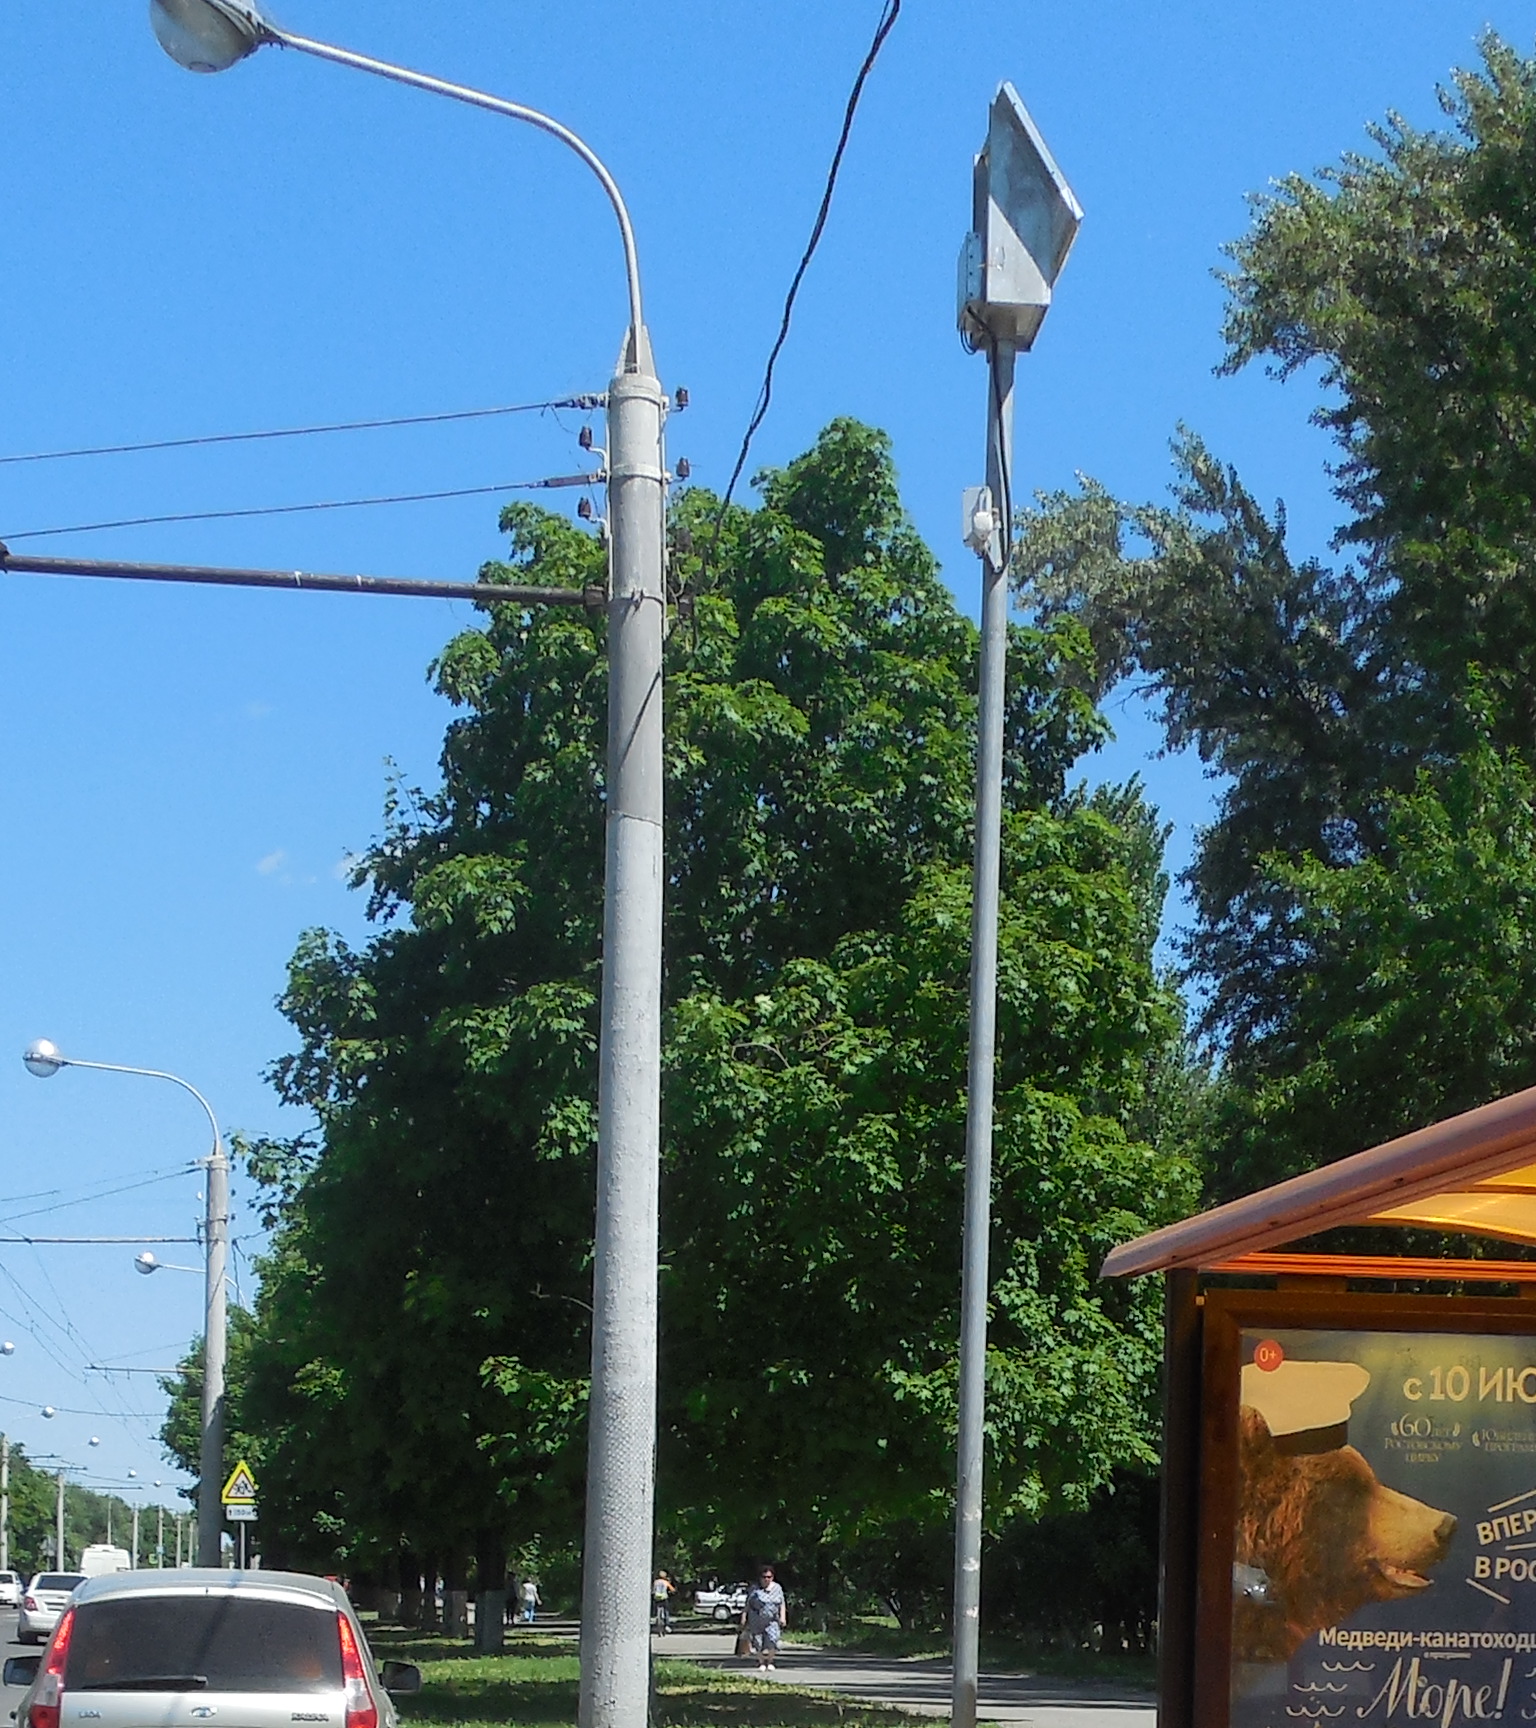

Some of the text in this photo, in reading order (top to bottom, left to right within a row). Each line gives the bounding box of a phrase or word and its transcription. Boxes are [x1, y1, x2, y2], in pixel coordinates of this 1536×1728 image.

[1259, 1347, 1277, 1363] 0+
[1429, 1365, 1471, 1402] 10
[1398, 1412, 1432, 1437] 60
[1474, 1555, 1492, 1579] В
